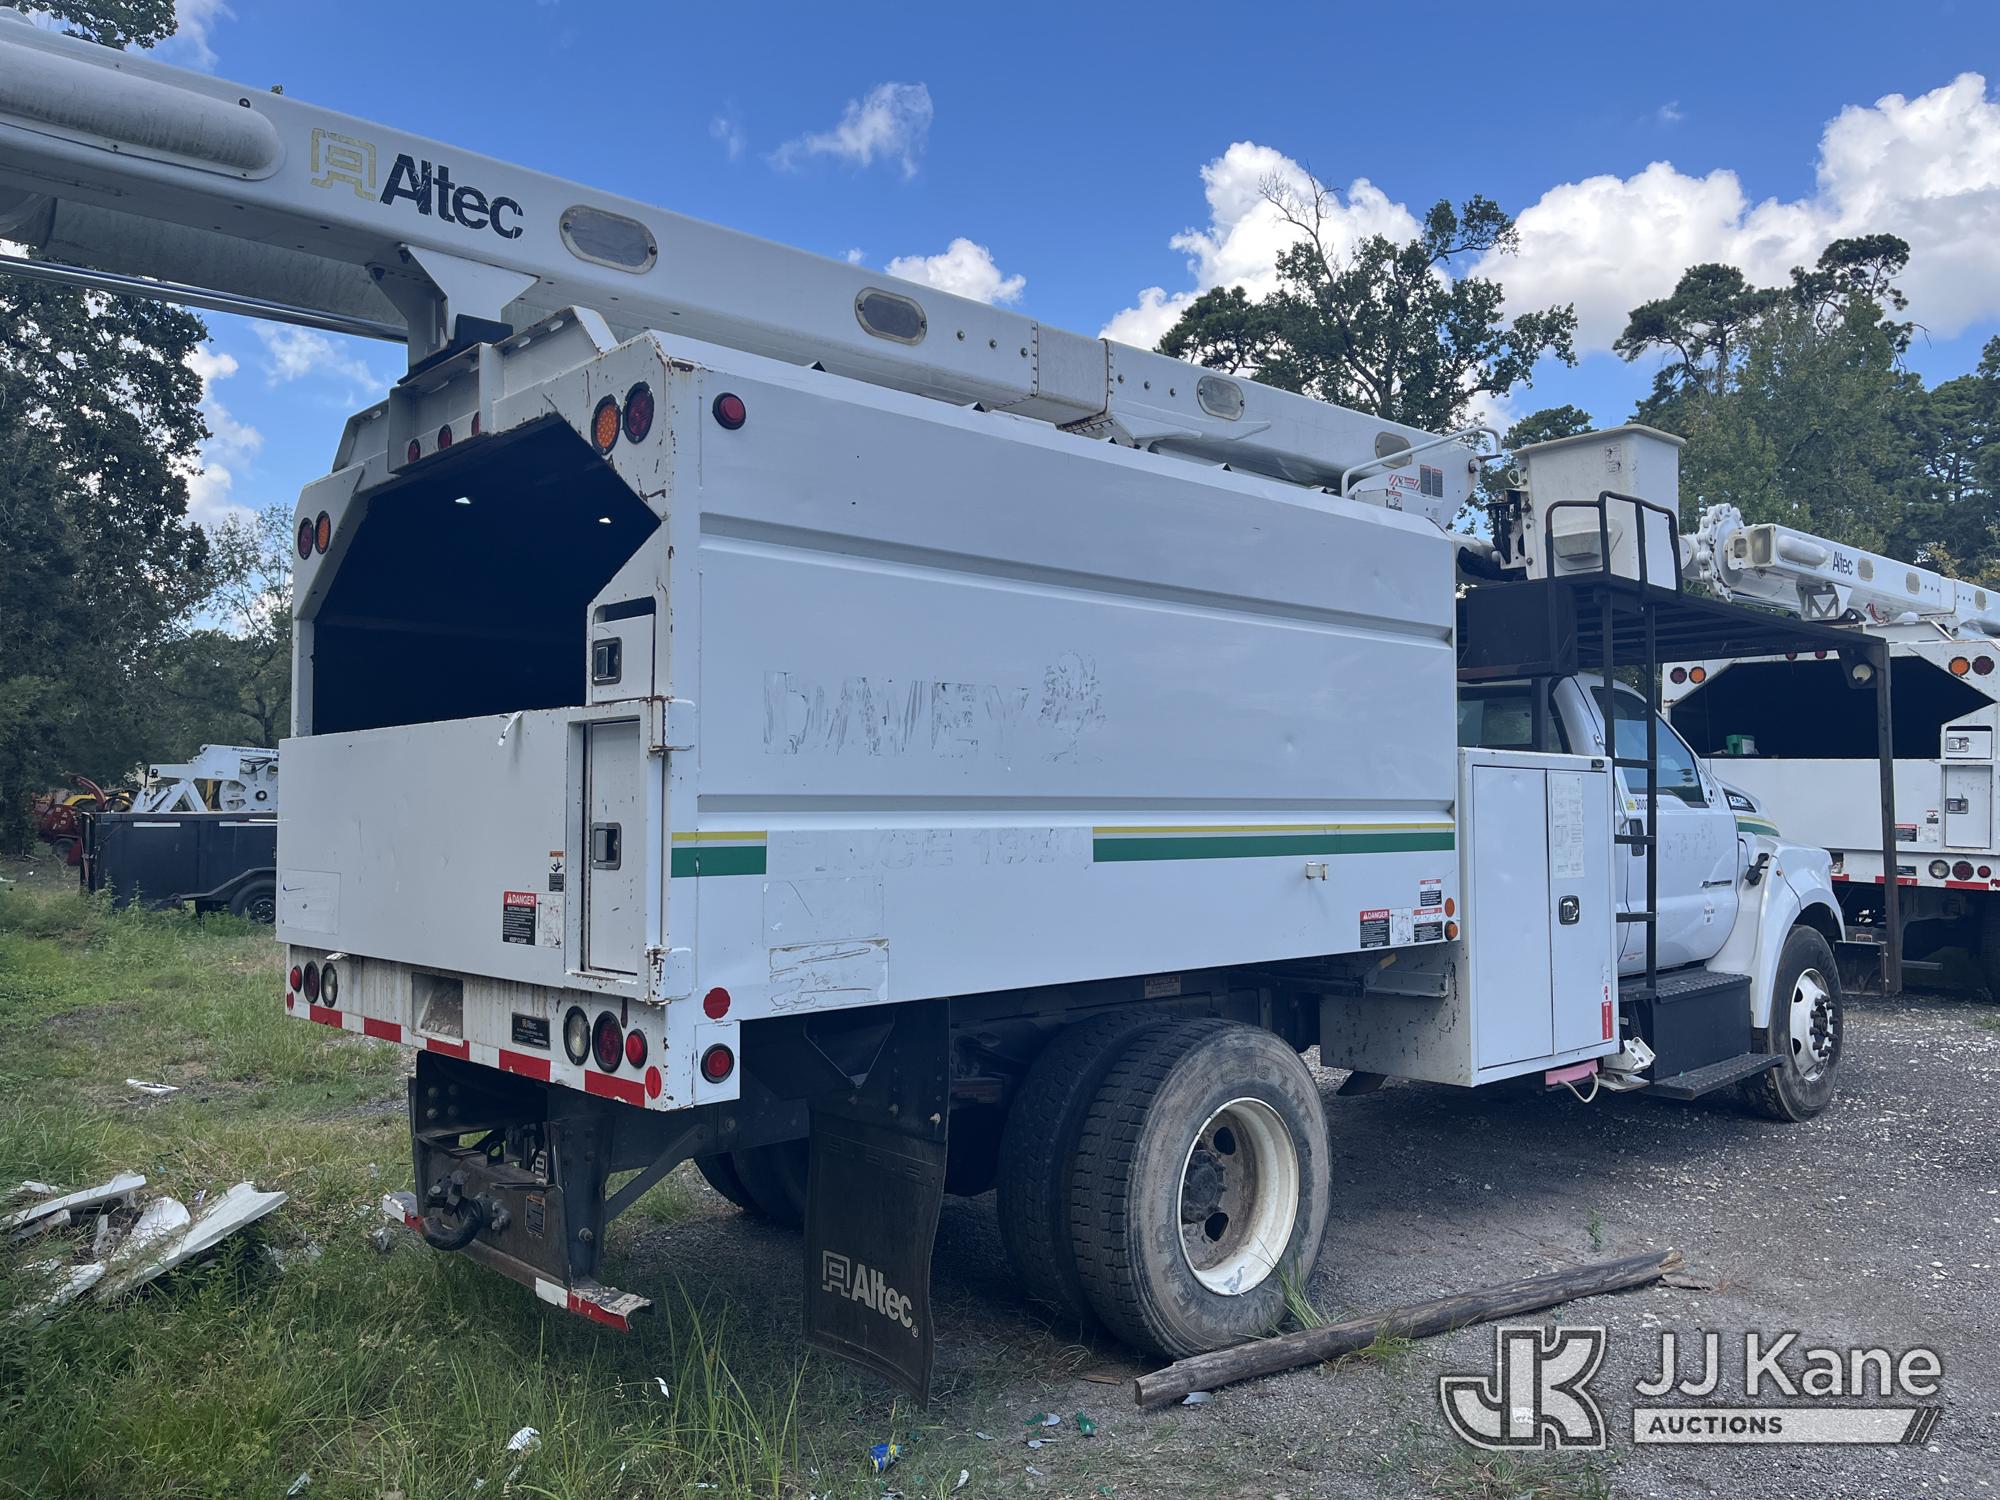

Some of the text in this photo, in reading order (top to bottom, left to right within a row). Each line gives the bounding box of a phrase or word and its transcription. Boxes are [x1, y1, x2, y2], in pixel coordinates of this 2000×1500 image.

[379, 153, 524, 240] Altec
[1832, 551, 1853, 576] Altec
[513, 895, 535, 905] DANGER
[1368, 911, 1388, 919] DANGER
[851, 1263, 913, 1328] Altec
